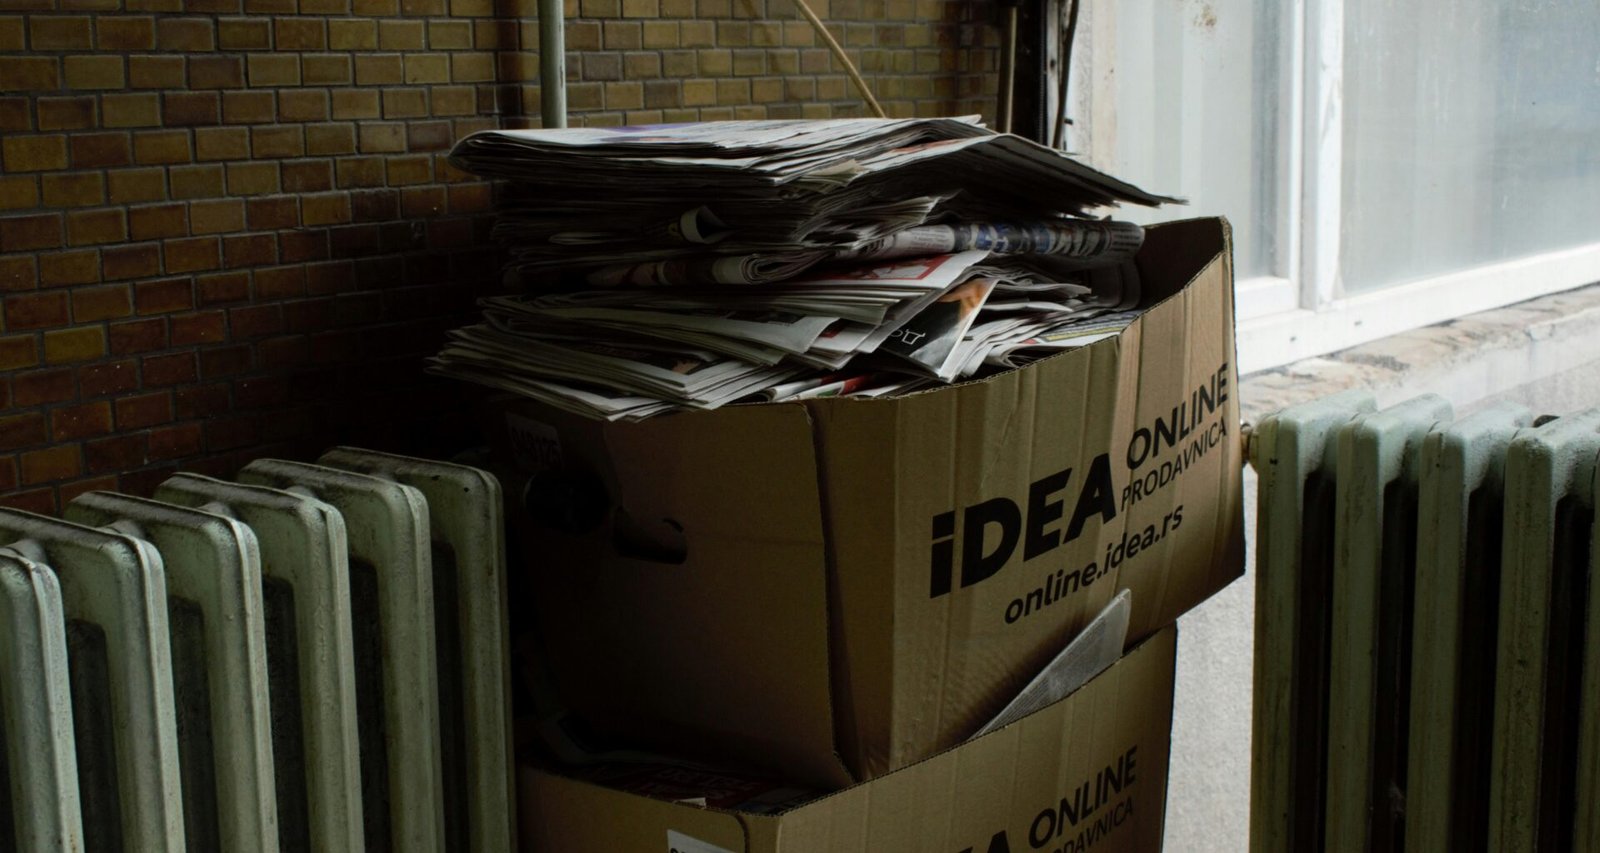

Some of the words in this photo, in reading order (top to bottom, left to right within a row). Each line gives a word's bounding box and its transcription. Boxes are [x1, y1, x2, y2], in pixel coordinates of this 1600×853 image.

[1121, 417, 1228, 512] PRODAVNICA
[1126, 363, 1229, 471] ONLINE
[1004, 505, 1184, 625] online.idea.rs
[1029, 746, 1138, 848] ONLINE
